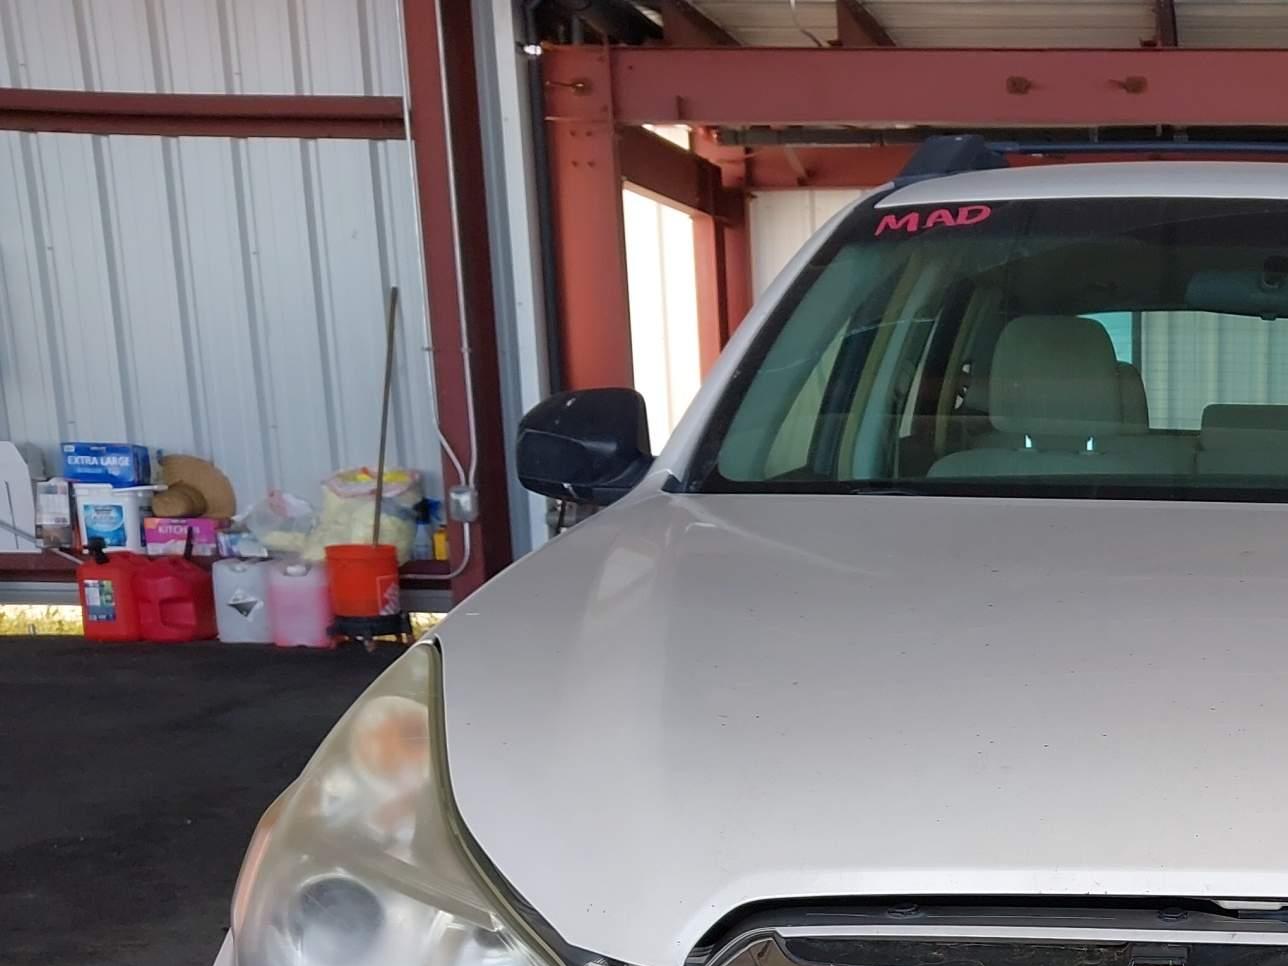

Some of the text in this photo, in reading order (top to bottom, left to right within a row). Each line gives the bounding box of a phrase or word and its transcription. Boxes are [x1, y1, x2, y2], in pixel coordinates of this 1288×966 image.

[873, 204, 992, 236] MAD
[67, 455, 130, 467] EXTRA LARGE
